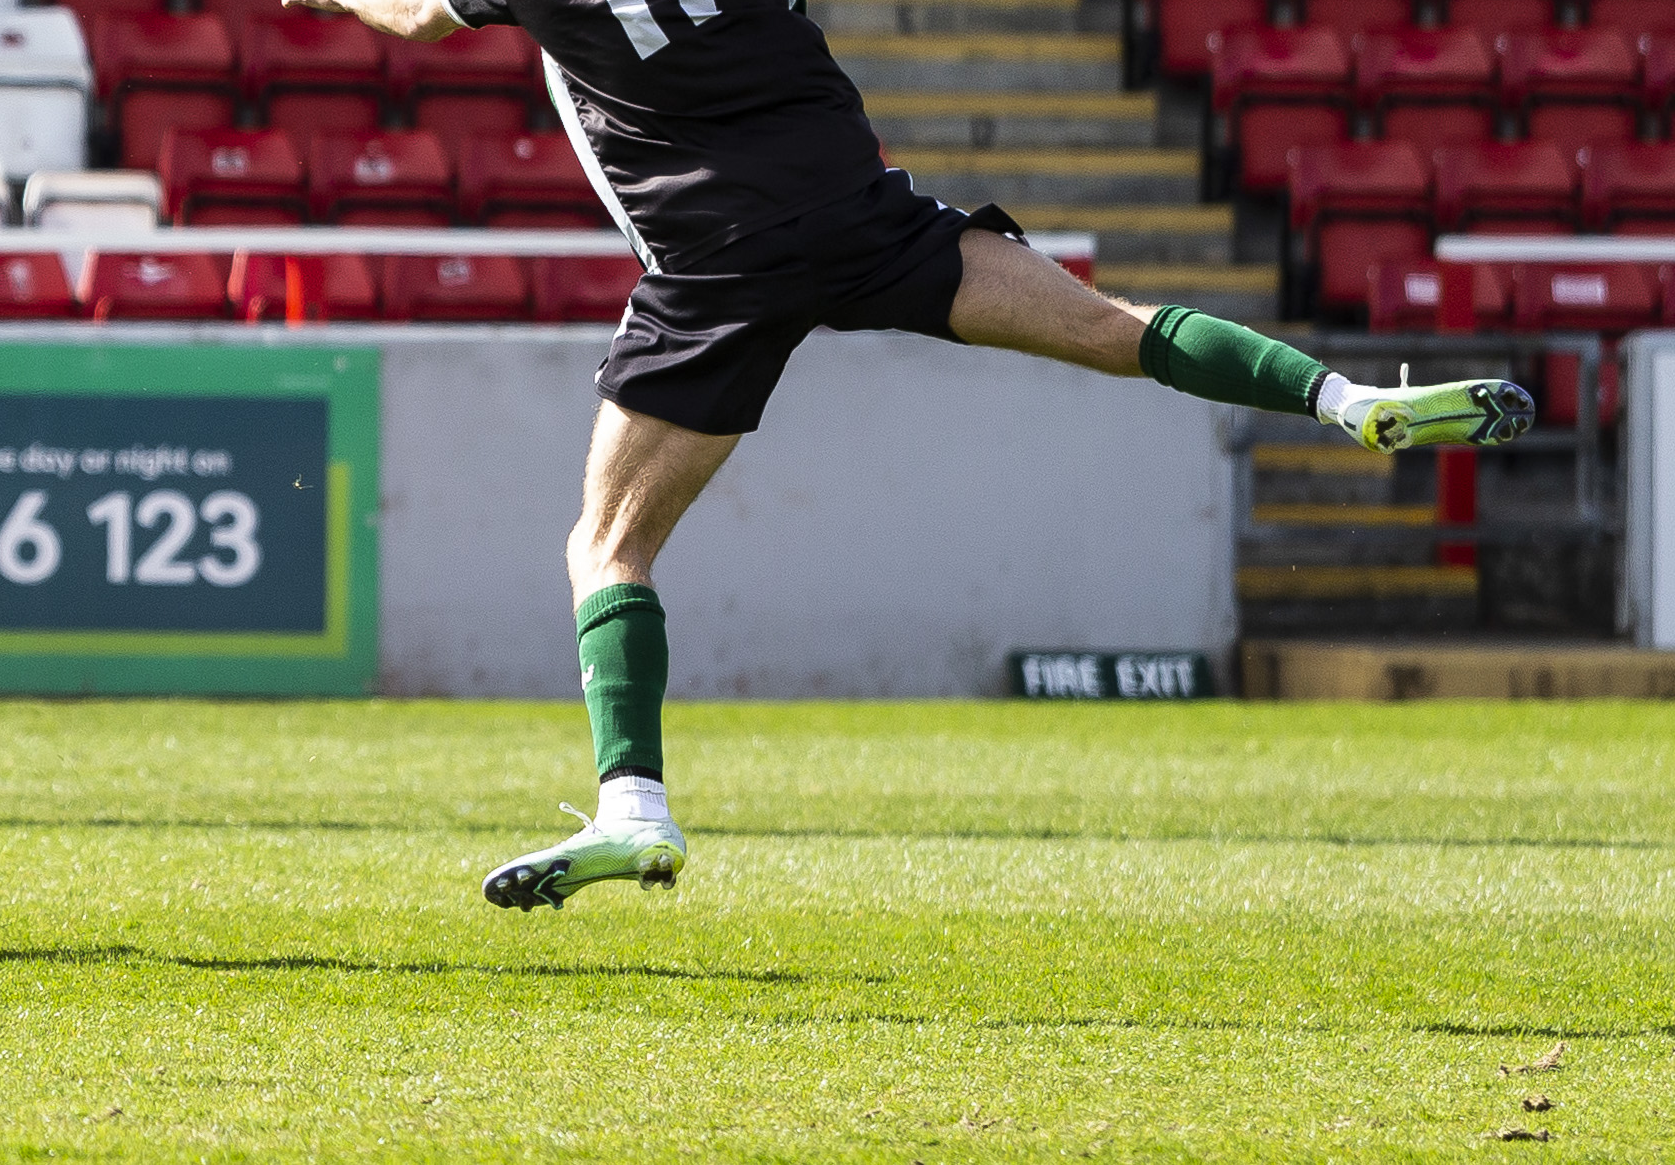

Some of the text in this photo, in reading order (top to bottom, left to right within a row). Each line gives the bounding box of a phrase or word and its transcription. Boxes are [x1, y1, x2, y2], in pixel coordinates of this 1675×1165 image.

[19, 441, 75, 480] day
[79, 448, 113, 475] or
[114, 443, 189, 482] night
[191, 448, 233, 476] on
[85, 488, 264, 587] 123
[1023, 654, 1194, 698] FIRE EXIT
